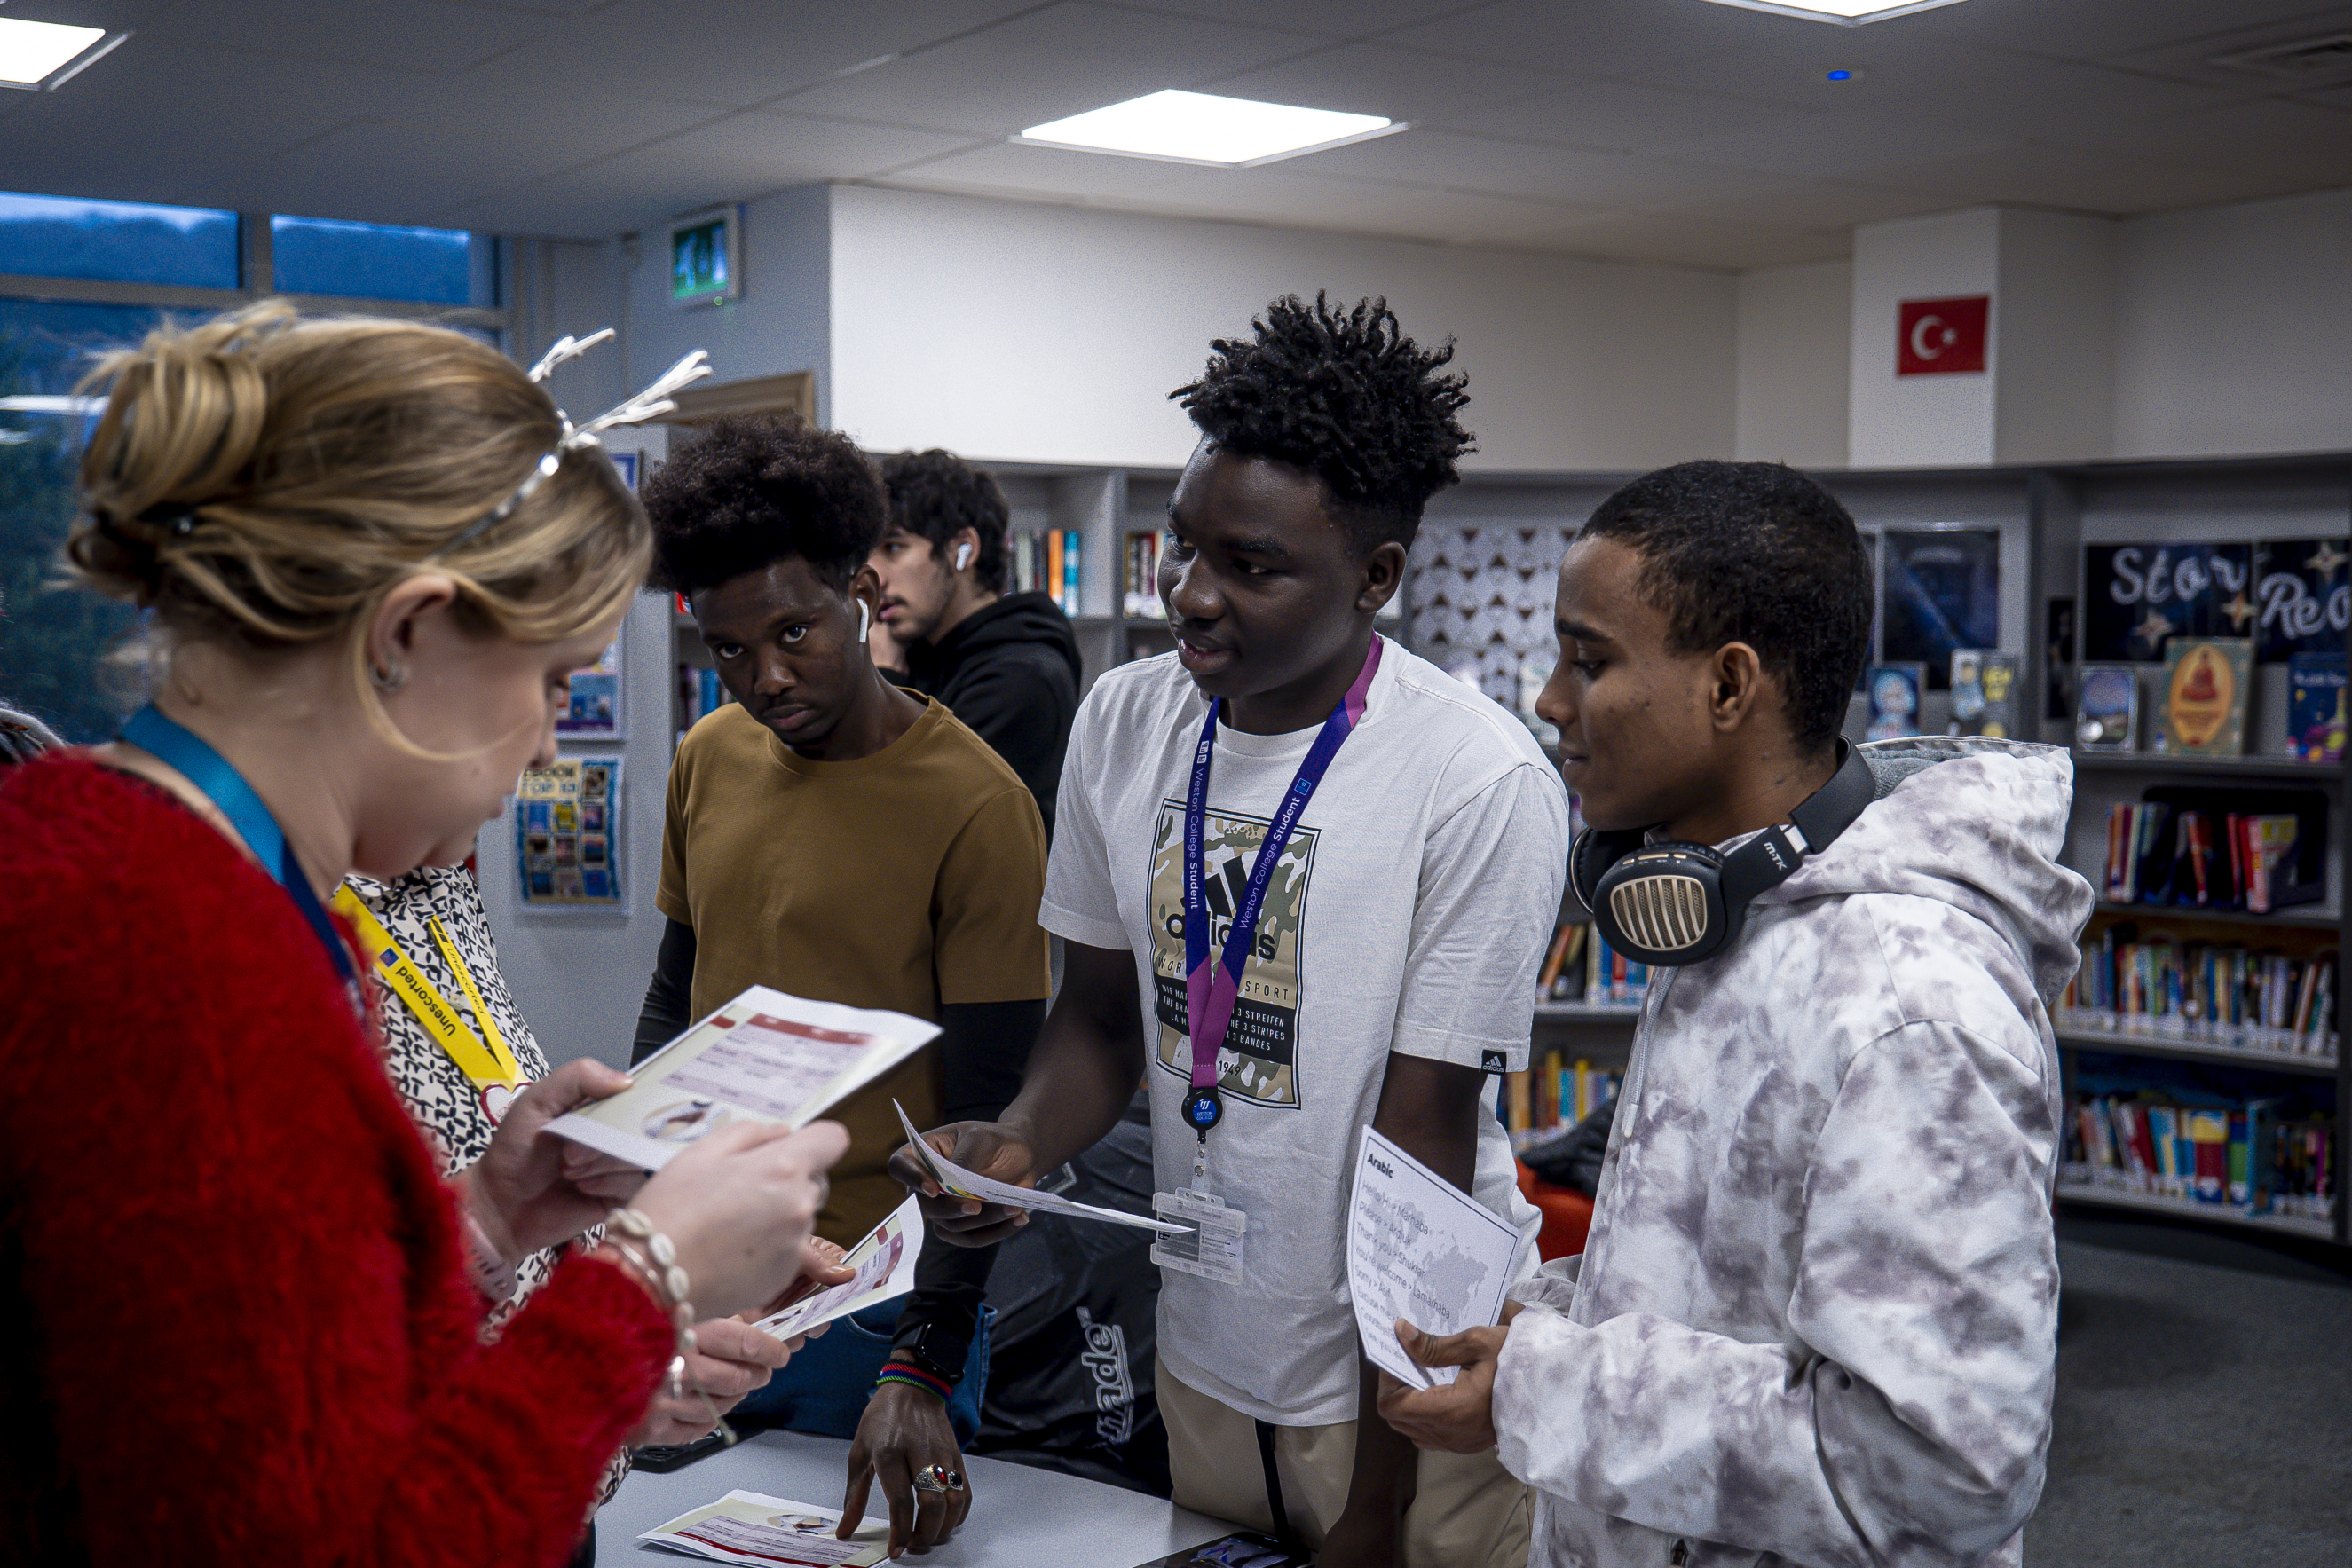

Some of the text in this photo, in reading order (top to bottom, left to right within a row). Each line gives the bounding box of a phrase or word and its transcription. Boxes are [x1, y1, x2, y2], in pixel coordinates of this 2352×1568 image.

[1188, 768, 1204, 910] Weston College Student
[1239, 797, 1301, 928] Weston College Student
[1165, 913, 1276, 960] ais
[395, 966, 456, 1036] Unescorted
[447, 948, 485, 1014] Unescorted
[1245, 981, 1289, 1000] SPORT
[1162, 984, 1173, 995] DIE
[1237, 1007, 1242, 1017] 3
[1245, 1010, 1285, 1028] STREIFEN
[1163, 995, 1173, 1008] THE
[1175, 1001, 1188, 1014] BRA
[1243, 1022, 1248, 1031] 3
[1251, 1024, 1285, 1041] STRIPES
[1171, 1013, 1179, 1023] LA
[1232, 1032, 1236, 1041] 3
[1240, 1034, 1271, 1051] BANDES
[1218, 1060, 1242, 1076] 1949
[1368, 1154, 1393, 1178] Arabic
[1397, 1205, 1428, 1234] Marhaba
[1398, 1251, 1425, 1279] Shukran
